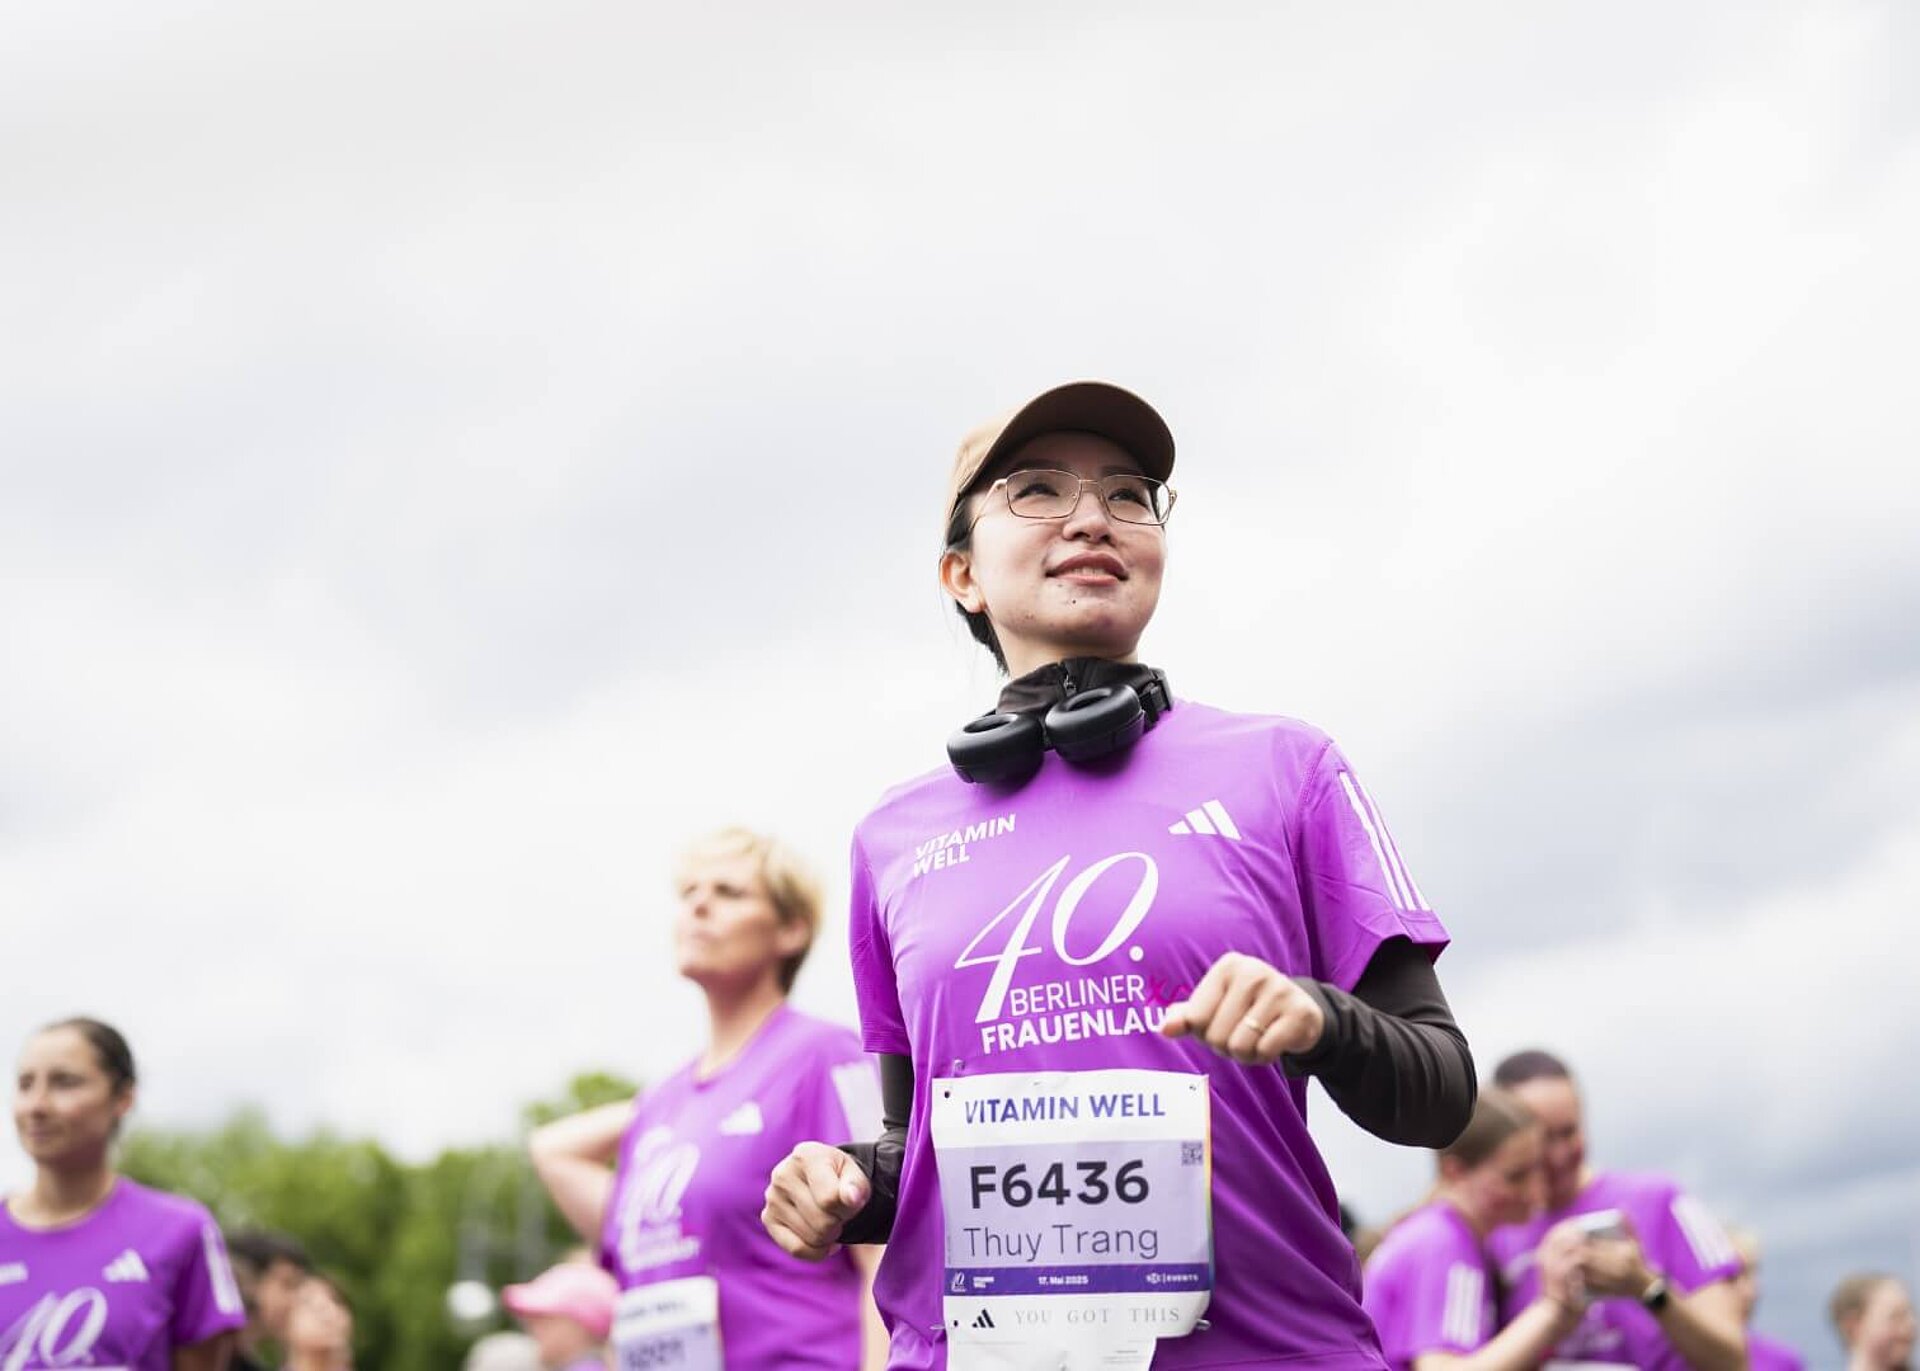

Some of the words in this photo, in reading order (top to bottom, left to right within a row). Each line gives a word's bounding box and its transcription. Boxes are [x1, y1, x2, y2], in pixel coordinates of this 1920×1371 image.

[915, 813, 1016, 860] VITAMIN
[913, 842, 970, 879] WELL
[953, 851, 1160, 1023] 40.
[1009, 974, 1146, 1017] BERLINER
[980, 1004, 1166, 1055] FRAUENLAU
[964, 1095, 1079, 1124] VITAMIN
[1089, 1093, 1166, 1118] WELL
[969, 1159, 1150, 1210] F6436
[963, 1226, 1042, 1262] Thuy
[1052, 1224, 1158, 1260] Trang
[1015, 1309, 1054, 1325] YOU
[1067, 1309, 1111, 1325] GOT
[1130, 1307, 1181, 1323] THIS
